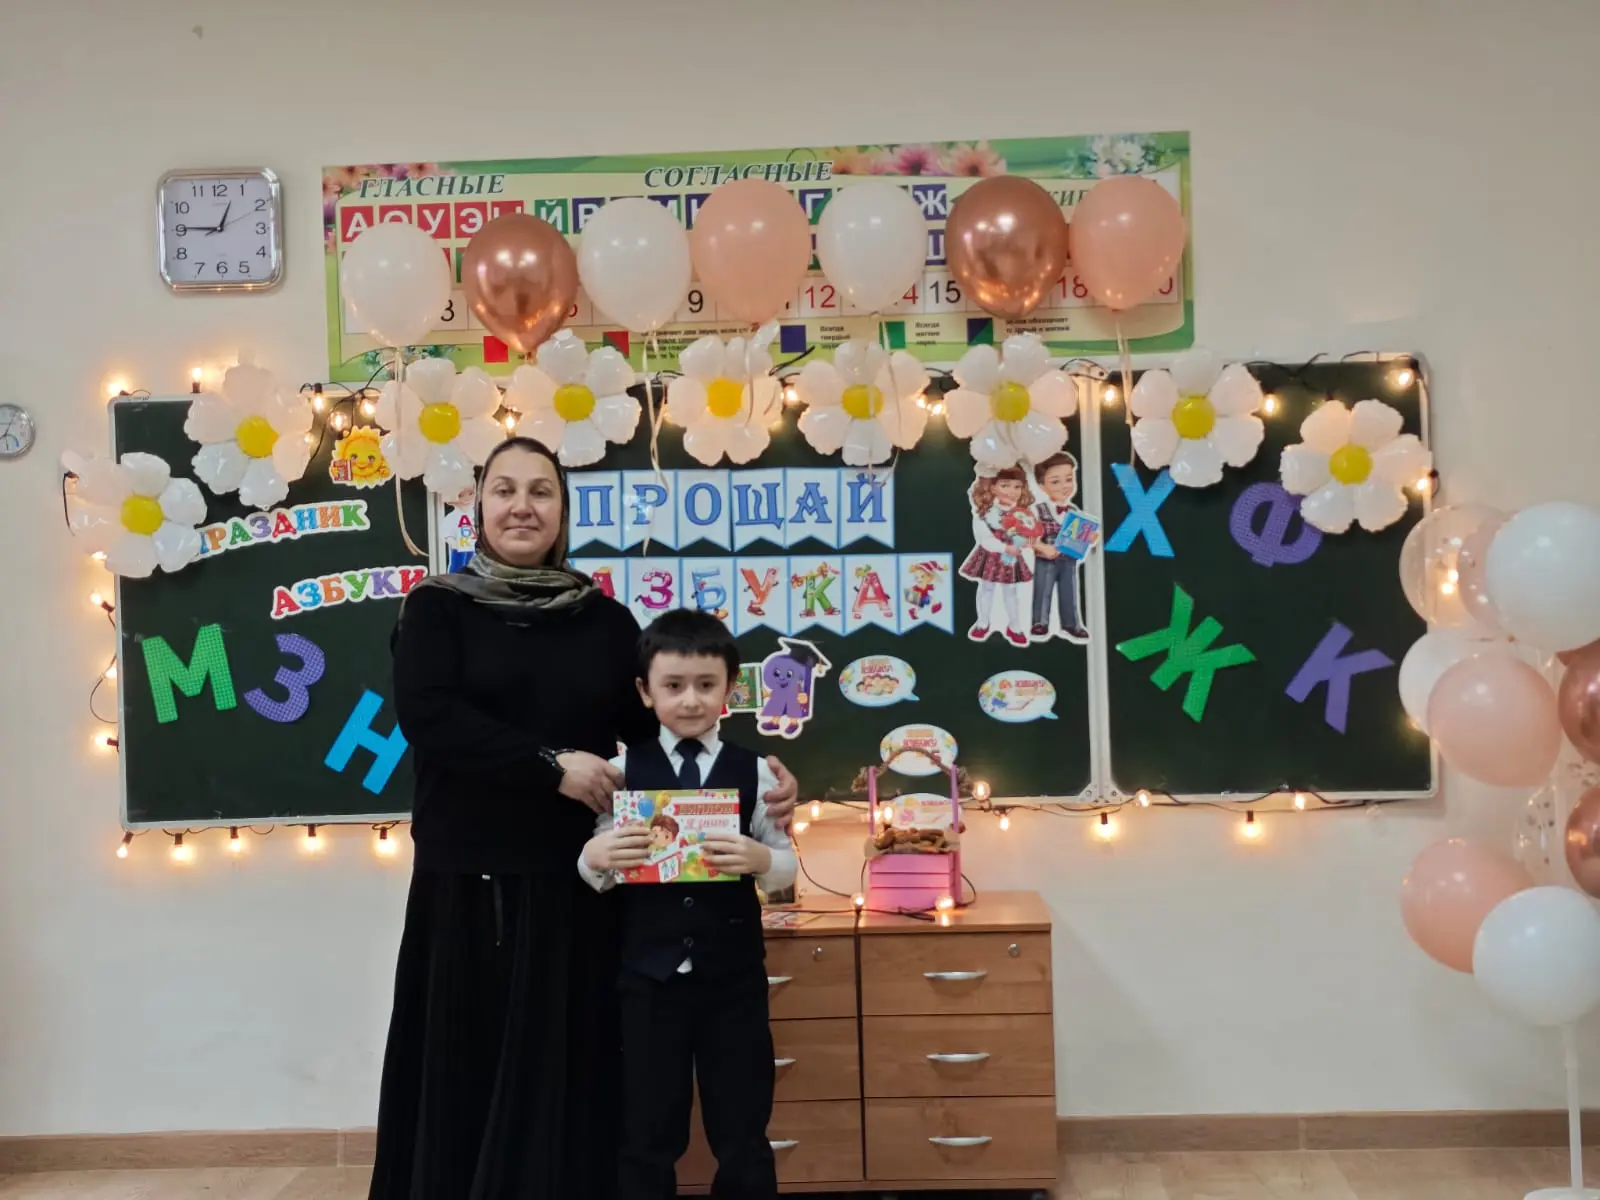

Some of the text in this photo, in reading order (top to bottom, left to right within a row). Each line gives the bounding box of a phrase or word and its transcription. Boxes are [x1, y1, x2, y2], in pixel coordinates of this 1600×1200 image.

[192, 185, 203, 197] 11
[212, 184, 227, 197] 12
[360, 175, 505, 198] ГЛАСНЫЕ
[645, 161, 833, 188] СОГЛАСНЫЕ
[174, 199, 266, 214] 10 2
[346, 212, 368, 239] А
[423, 209, 445, 233] У
[460, 208, 483, 233] Э
[805, 193, 825, 219] Г
[914, 189, 948, 216] Ж
[176, 222, 266, 237] 9 3
[176, 245, 266, 260] 8 4
[195, 261, 250, 275] 7 6 5
[688, 289, 704, 313] 9
[805, 284, 837, 309] 12
[929, 280, 961, 304] 15
[576, 473, 886, 529] ПРОЩАЙ
[1104, 463, 1324, 567] Х Ф
[274, 567, 426, 616] АЗБУКИ
[142, 623, 237, 723] М
[1115, 583, 1396, 735] Ж К
[324, 688, 409, 795] Н
